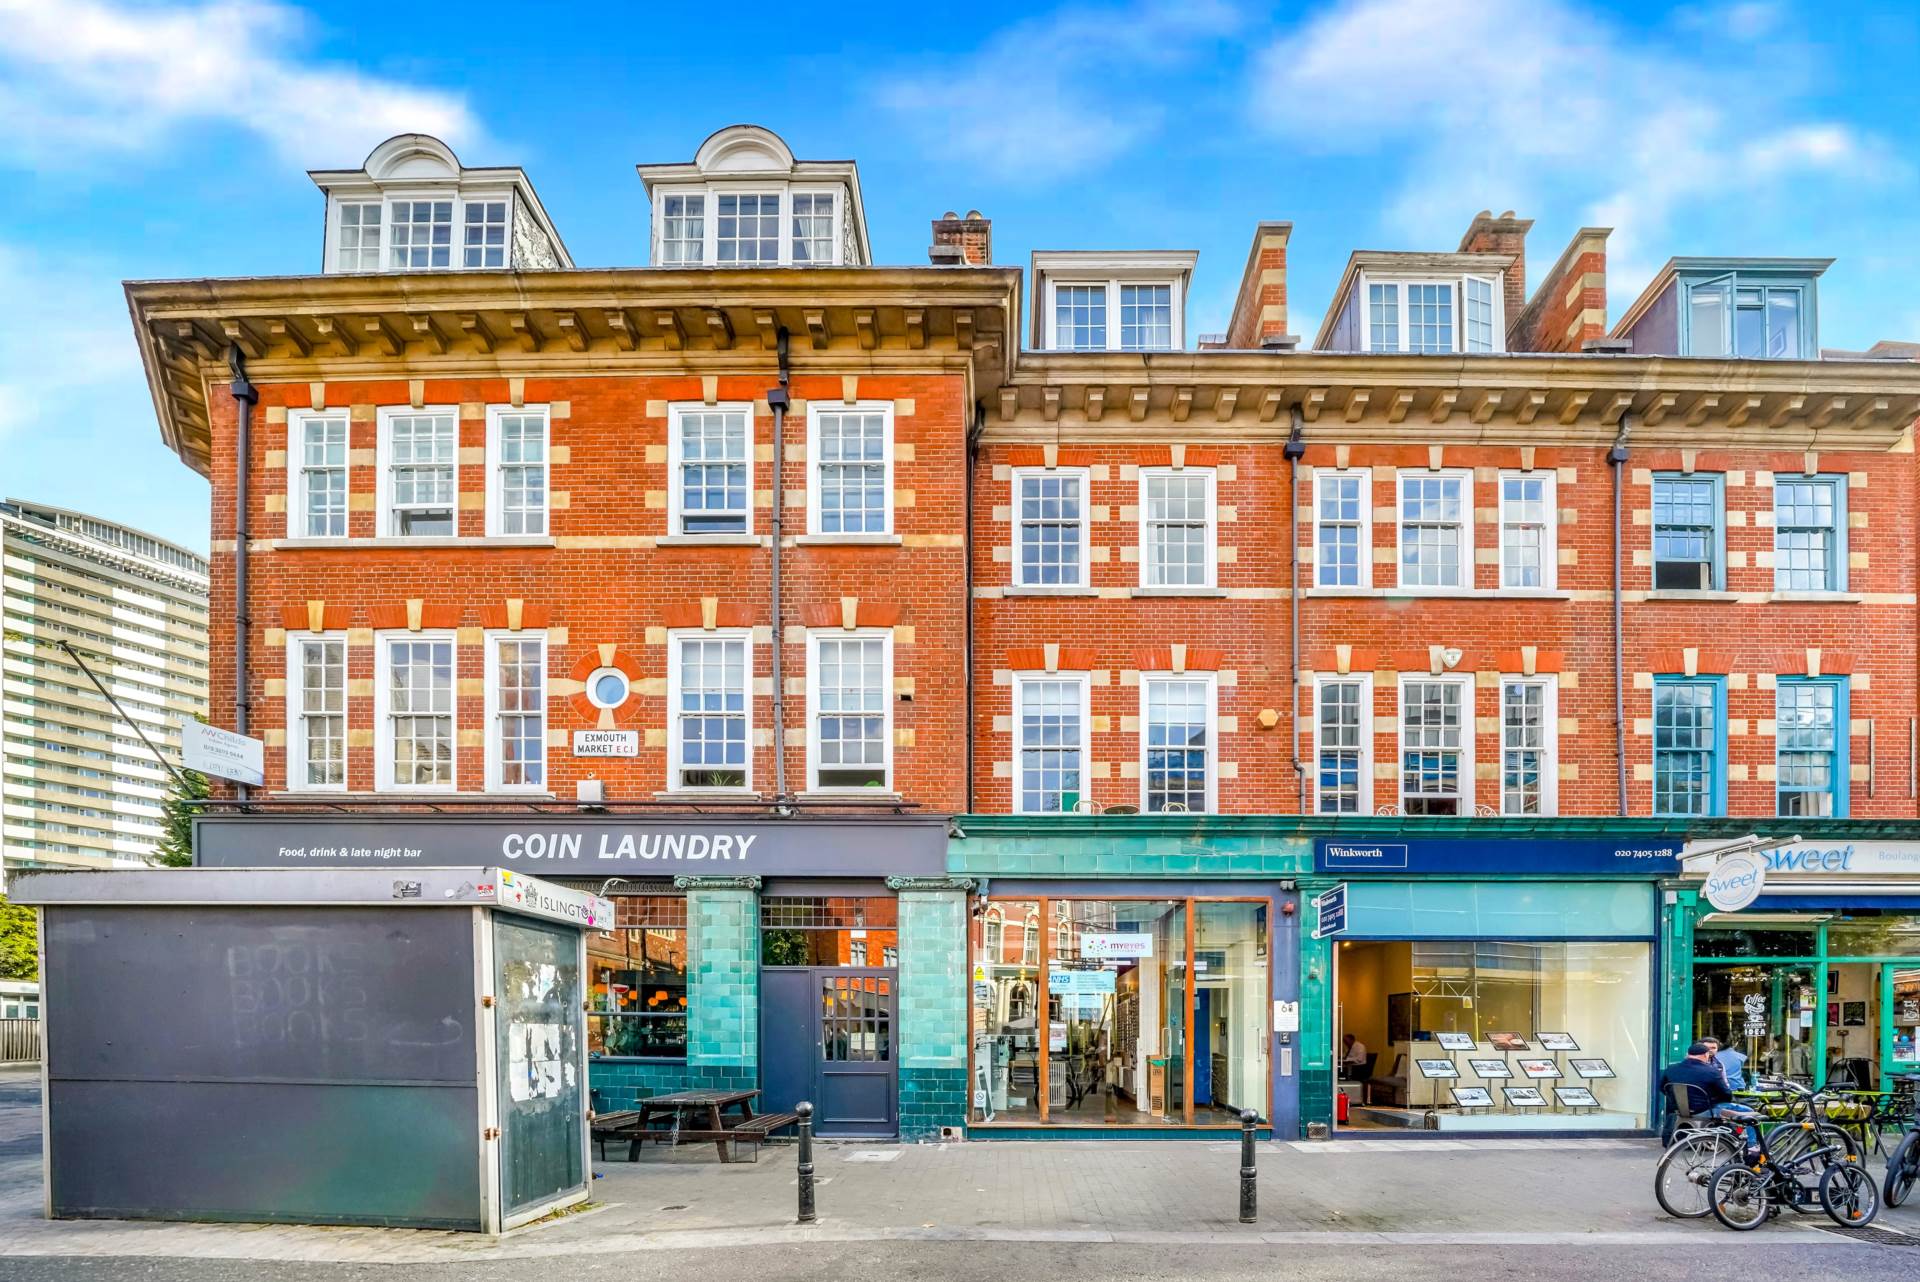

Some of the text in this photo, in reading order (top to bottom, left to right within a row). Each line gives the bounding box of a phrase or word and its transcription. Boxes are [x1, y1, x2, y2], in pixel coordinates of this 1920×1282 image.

[585, 734, 627, 742] EXMOUTH
[577, 745, 613, 753] MARKET
[502, 833, 757, 860] COIN LAUNDRY
[1329, 847, 1383, 857] Winkworth
[279, 847, 422, 859] Food, drink & late night bar
[1632, 850, 1653, 858] 7405
[1654, 848, 1673, 857] 1288
[1709, 868, 1758, 894] Sweet
[1743, 993, 1767, 1005] Coffee
